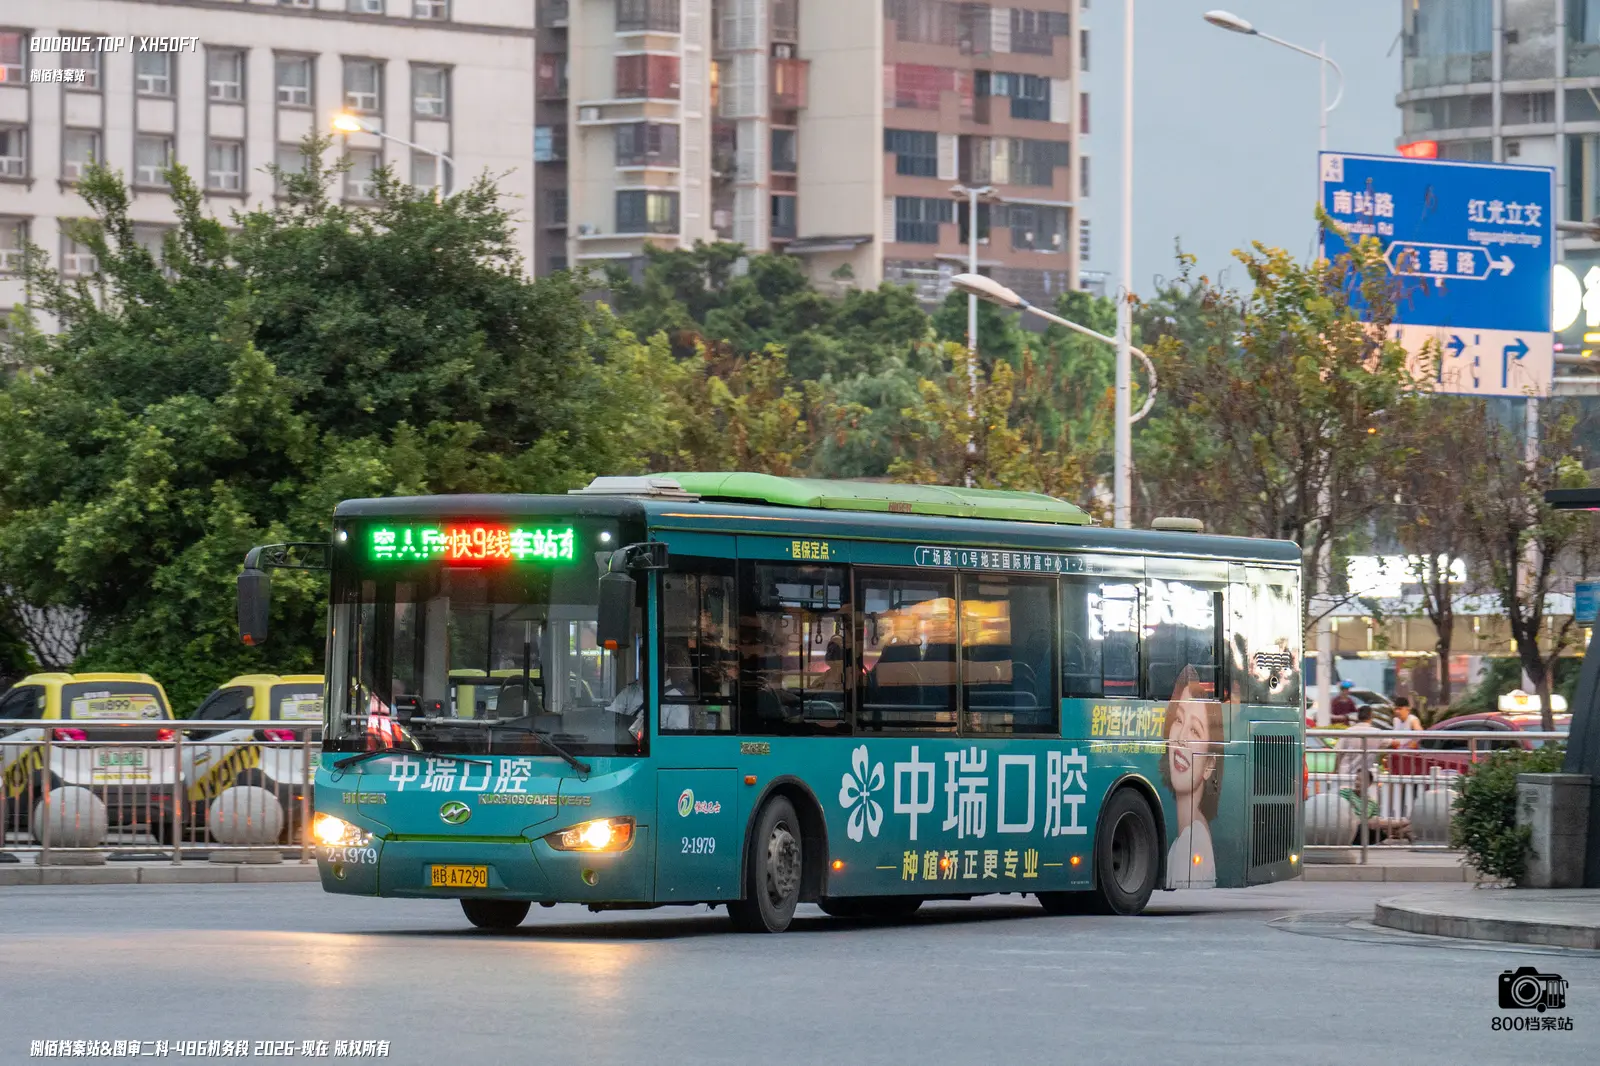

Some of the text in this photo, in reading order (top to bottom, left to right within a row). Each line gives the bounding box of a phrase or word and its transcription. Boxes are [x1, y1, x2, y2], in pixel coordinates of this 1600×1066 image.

[1333, 189, 1395, 218] 南站路
[1467, 198, 1542, 227] 红光立交
[452, 527, 510, 558] 快9线
[791, 541, 830, 559] 医保定点
[1091, 705, 1166, 738] 舒适化种牙
[389, 755, 532, 793] 中瑞口腔
[342, 792, 387, 804] HIGER
[893, 745, 1089, 841] 中瑞口腔
[326, 847, 378, 865] 2-1979
[902, 848, 1039, 881] 种植矫正更专业
